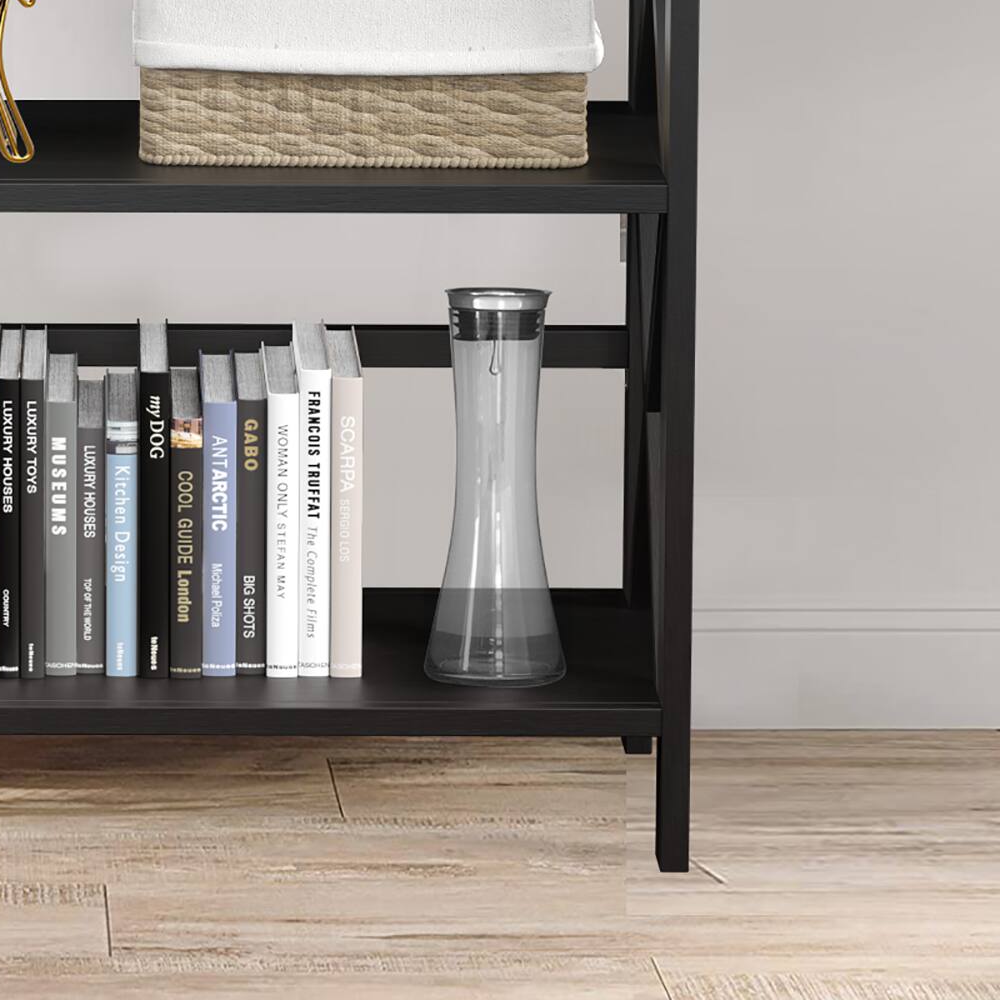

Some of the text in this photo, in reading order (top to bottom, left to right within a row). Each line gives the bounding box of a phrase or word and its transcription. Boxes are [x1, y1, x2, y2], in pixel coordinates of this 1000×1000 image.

[2, 401, 13, 513] LUXURY HOUSES
[26, 401, 37, 494] LUXURY TOYS
[52, 437, 66, 536] MUSEUMS
[149, 420, 164, 459] DOG
[212, 436, 227, 531] ANTARCTIC
[244, 419, 258, 471] GABO
[83, 445, 96, 538] LUXURY HOUSES
[111, 466, 130, 582] Kitchen Design
[277, 425, 288, 599] WOMAN ONLY STEFAN MAY
[304, 391, 320, 638] FRANCOIS TRUFFAT The Complete Films
[340, 415, 355, 562] SCARPA SERGIO LOS
[178, 471, 192, 622] COOL GUIDE London
[2, 589, 10, 627] COUNTRY
[83, 578, 92, 641] TOP OF THE WORLD
[211, 563, 223, 628] Michael Poliza
[243, 576, 255, 638] BIG SHOTS
